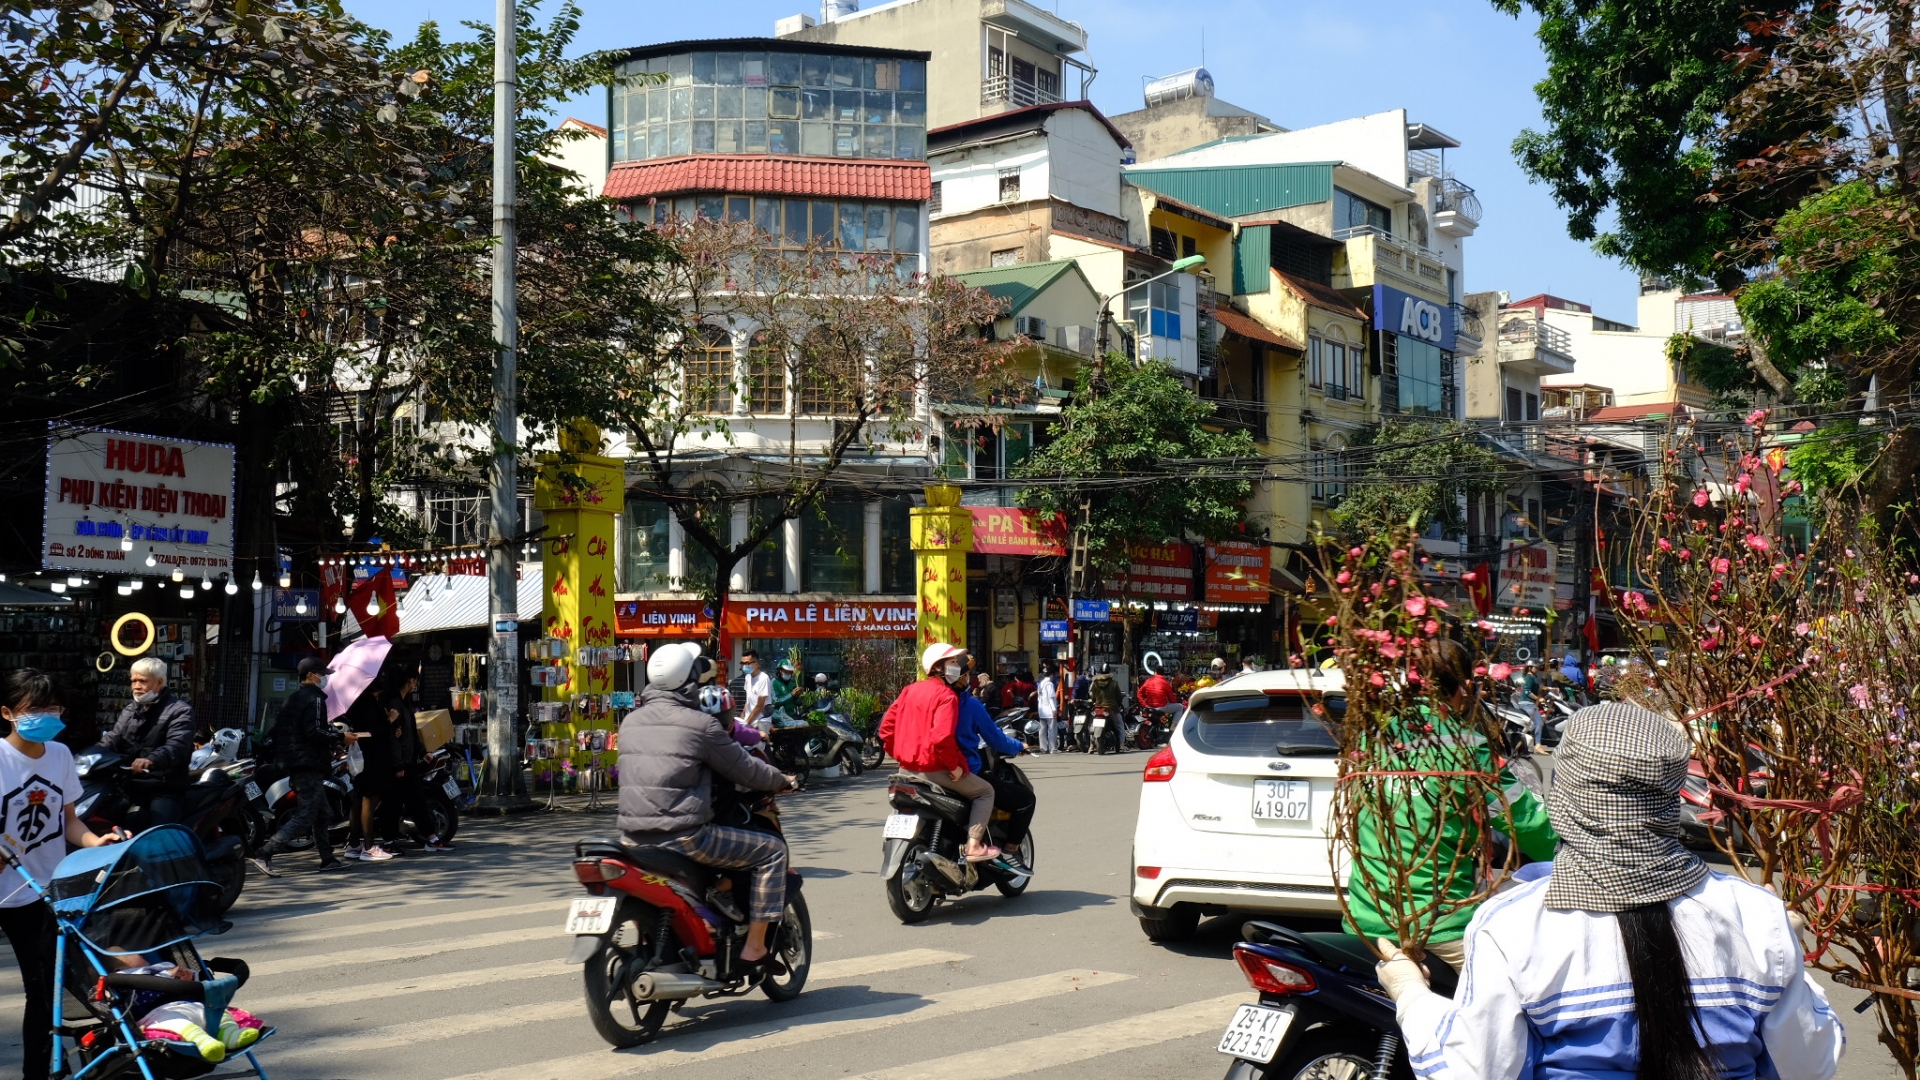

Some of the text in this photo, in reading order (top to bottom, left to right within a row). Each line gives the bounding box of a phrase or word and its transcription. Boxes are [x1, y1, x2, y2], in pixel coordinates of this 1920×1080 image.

[1401, 296, 1442, 342] ACB
[106, 438, 186, 478] HUDA
[59, 477, 227, 523] PHỤ KIỆN ĐIỆN THOẠI
[989, 514, 1014, 532] PA
[66, 544, 125, 560] SỐ 2 ĐỒNG XUÂN
[190, 556, 205, 565] 0972
[207, 557, 218, 567] 139
[219, 558, 228, 567] 114
[642, 610, 667, 624] LIÊN
[670, 613, 696, 624] VINH
[746, 604, 917, 622] PHA LÊ LIÊN VINH
[1077, 608, 1093, 618] HÀNG
[863, 623, 891, 631] HÀNG
[893, 622, 917, 631] GIẤY
[1267, 782, 1297, 799] 30F
[1254, 800, 1307, 819] 419.07
[1236, 1008, 1281, 1034] 29-K1
[1221, 1030, 1275, 1058] 823.50
